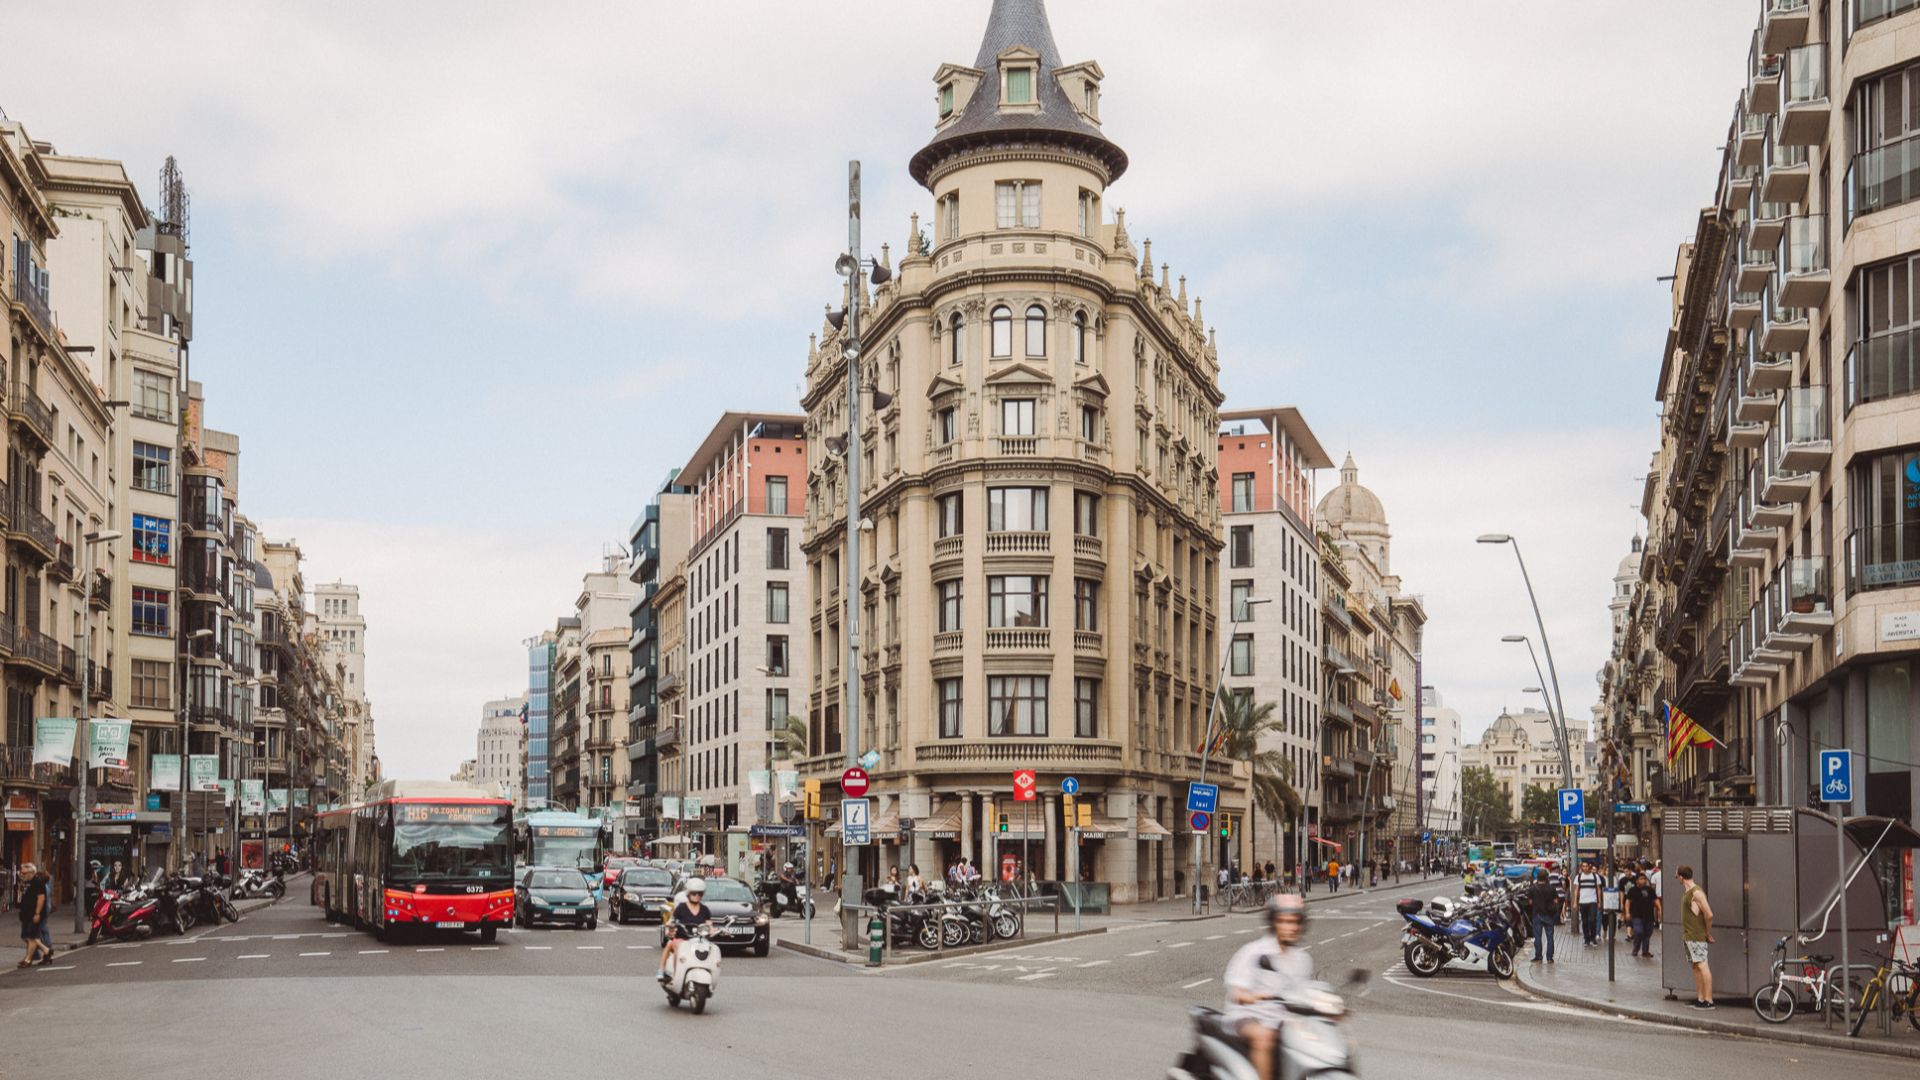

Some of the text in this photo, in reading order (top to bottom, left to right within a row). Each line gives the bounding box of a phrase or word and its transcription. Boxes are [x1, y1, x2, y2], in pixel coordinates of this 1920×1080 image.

[1828, 757, 1842, 775] P
[1563, 792, 1578, 810] P
[407, 807, 429, 821] H16
